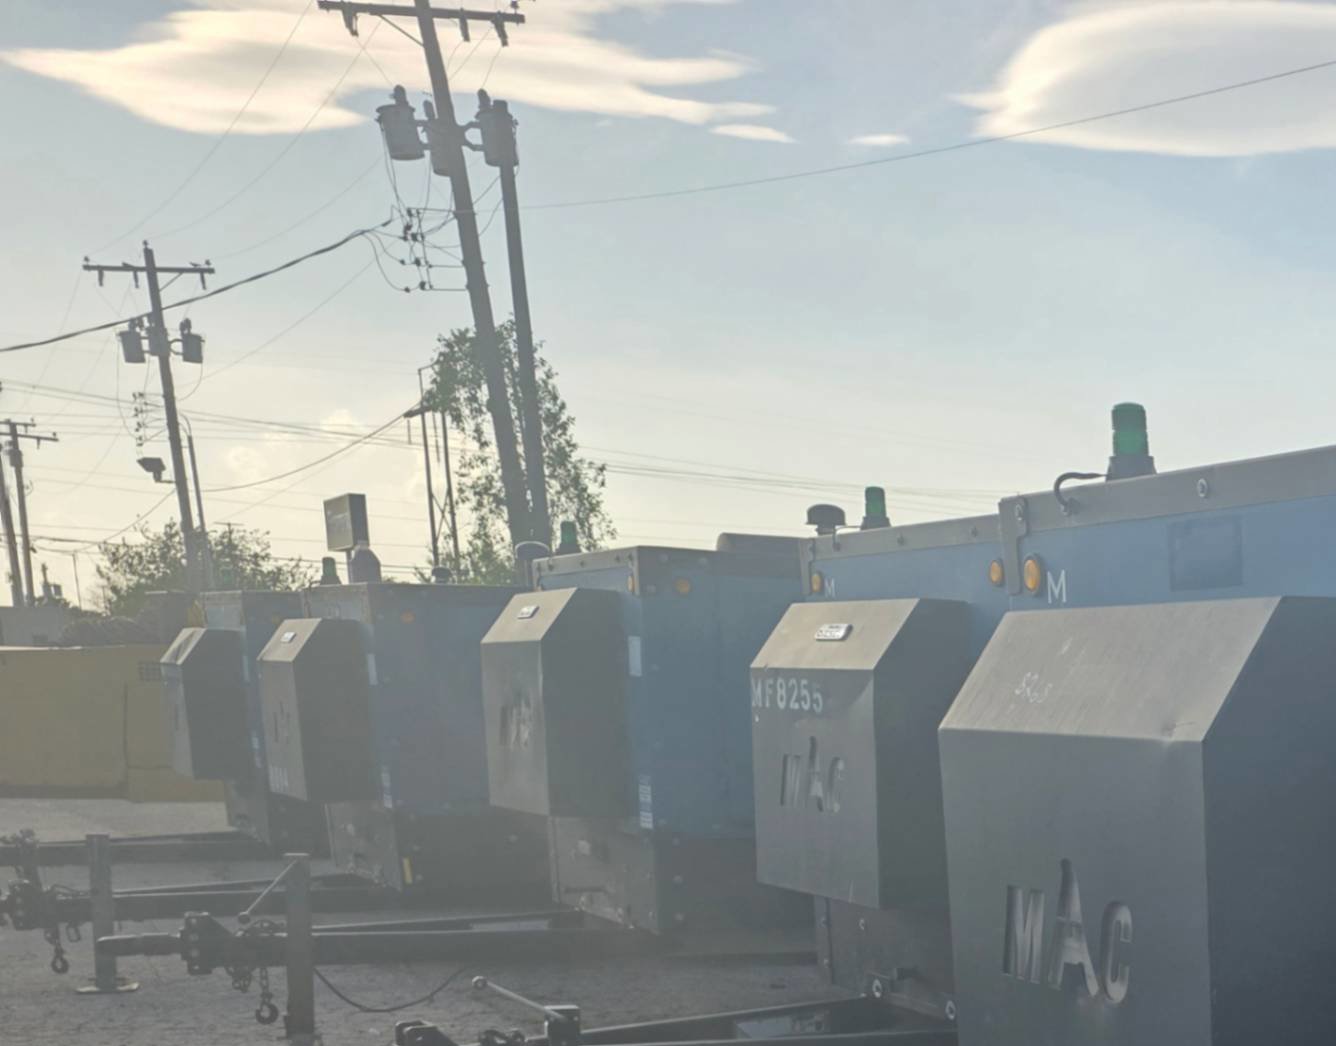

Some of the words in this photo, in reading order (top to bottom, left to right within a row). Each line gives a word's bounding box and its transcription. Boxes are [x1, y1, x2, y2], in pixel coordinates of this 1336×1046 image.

[1046, 568, 1068, 604] M
[751, 677, 824, 714] MF8255
[779, 736, 845, 813] MAC
[1002, 858, 1134, 1005] MAC
